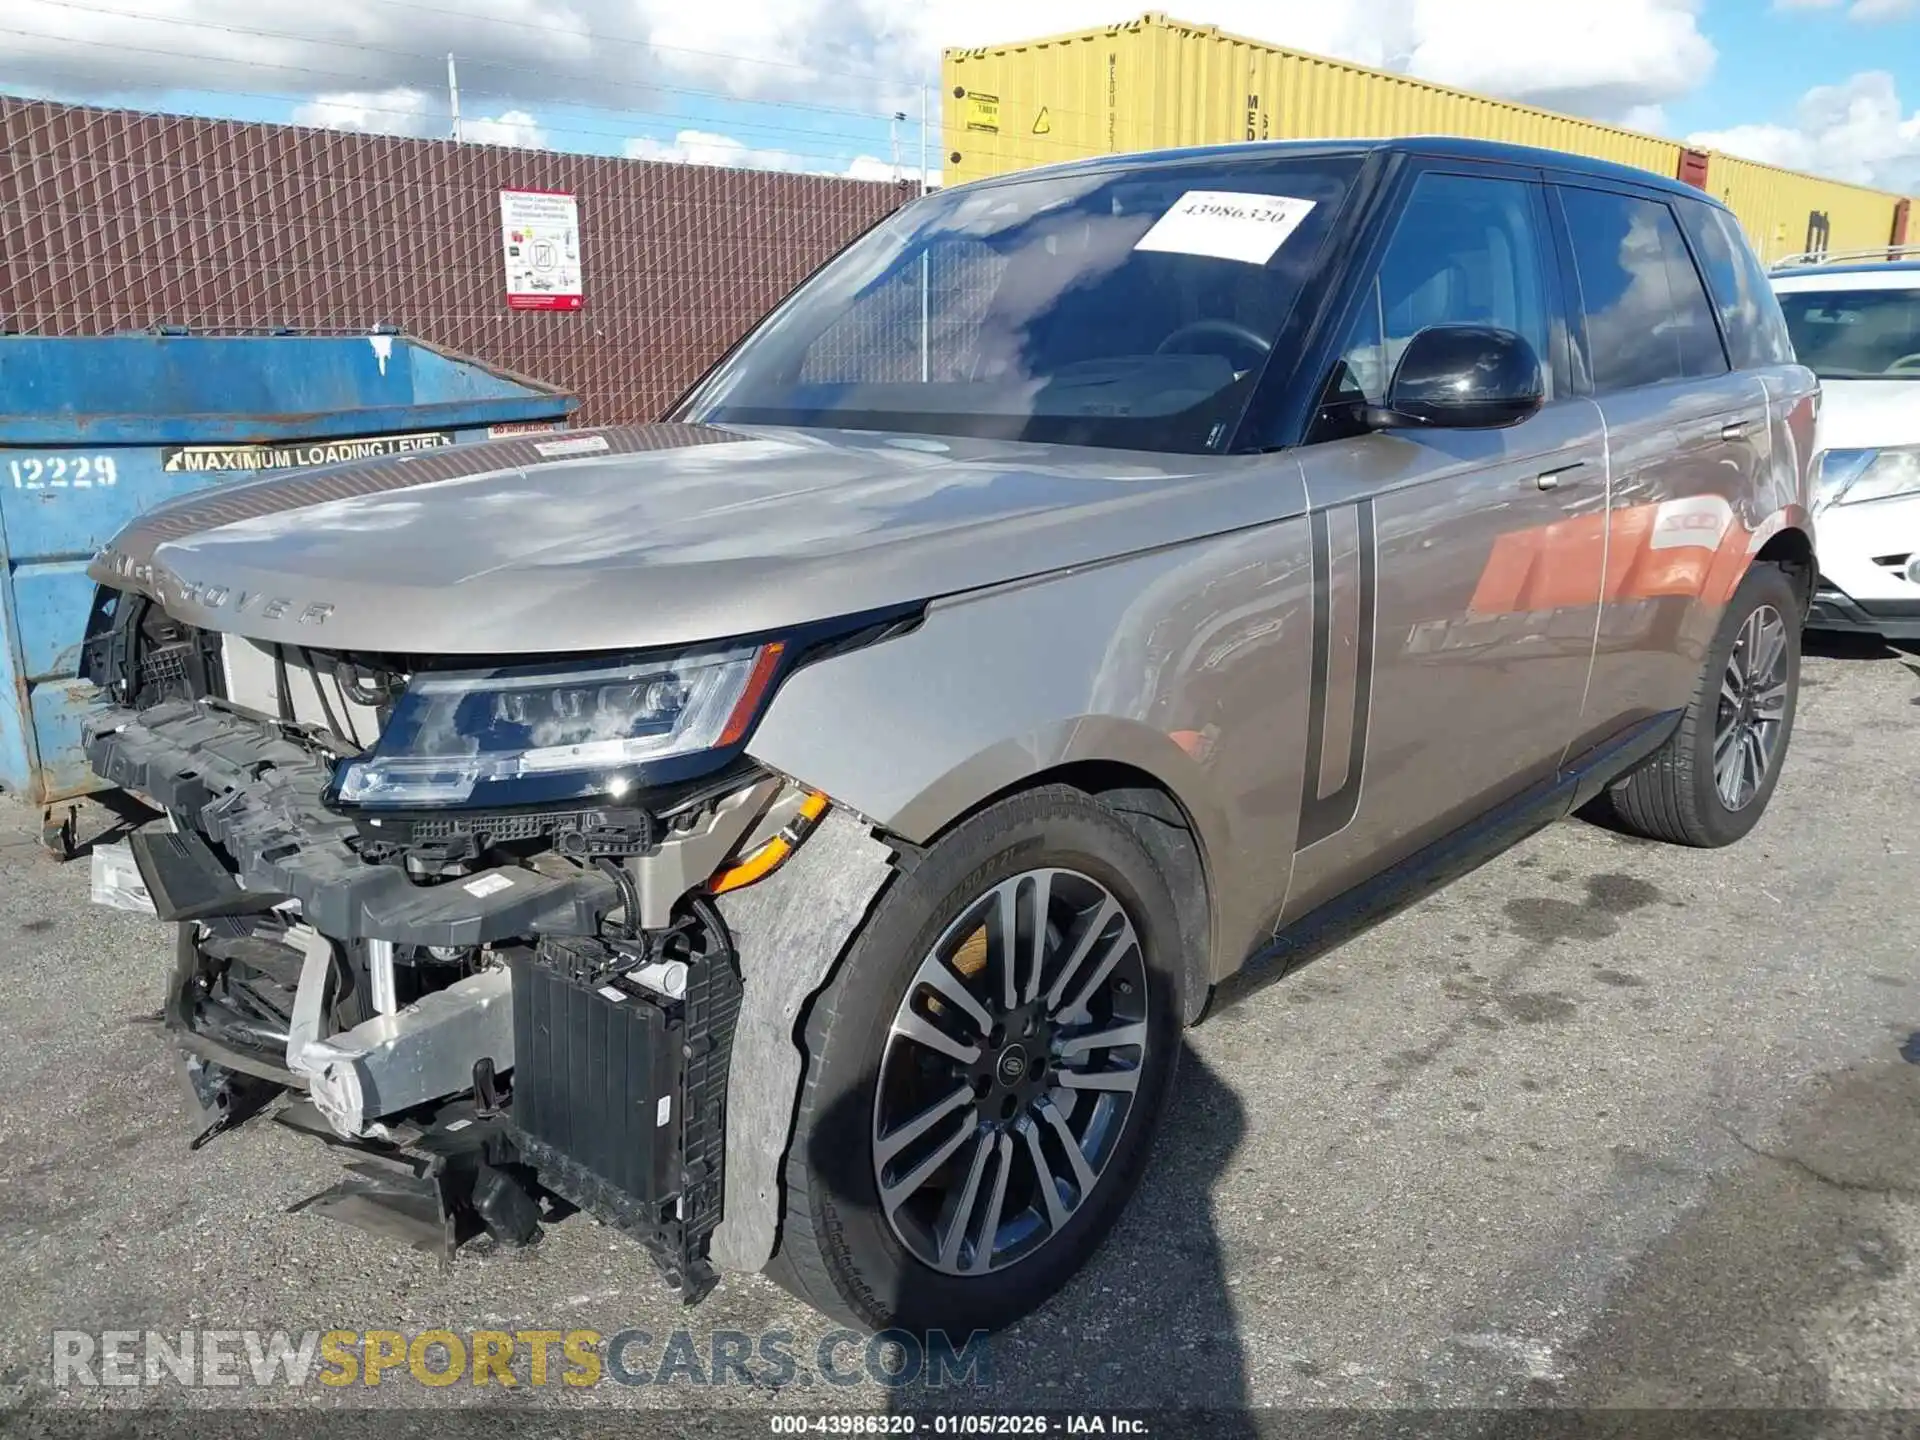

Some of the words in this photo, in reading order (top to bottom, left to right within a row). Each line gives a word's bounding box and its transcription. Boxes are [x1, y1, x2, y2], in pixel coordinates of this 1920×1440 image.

[1182, 204, 1287, 223] 43986320
[10, 455, 117, 489] 12229
[184, 450, 290, 471] MAXIMUM
[295, 441, 384, 466] LOADING
[180, 581, 336, 625] ROVER
